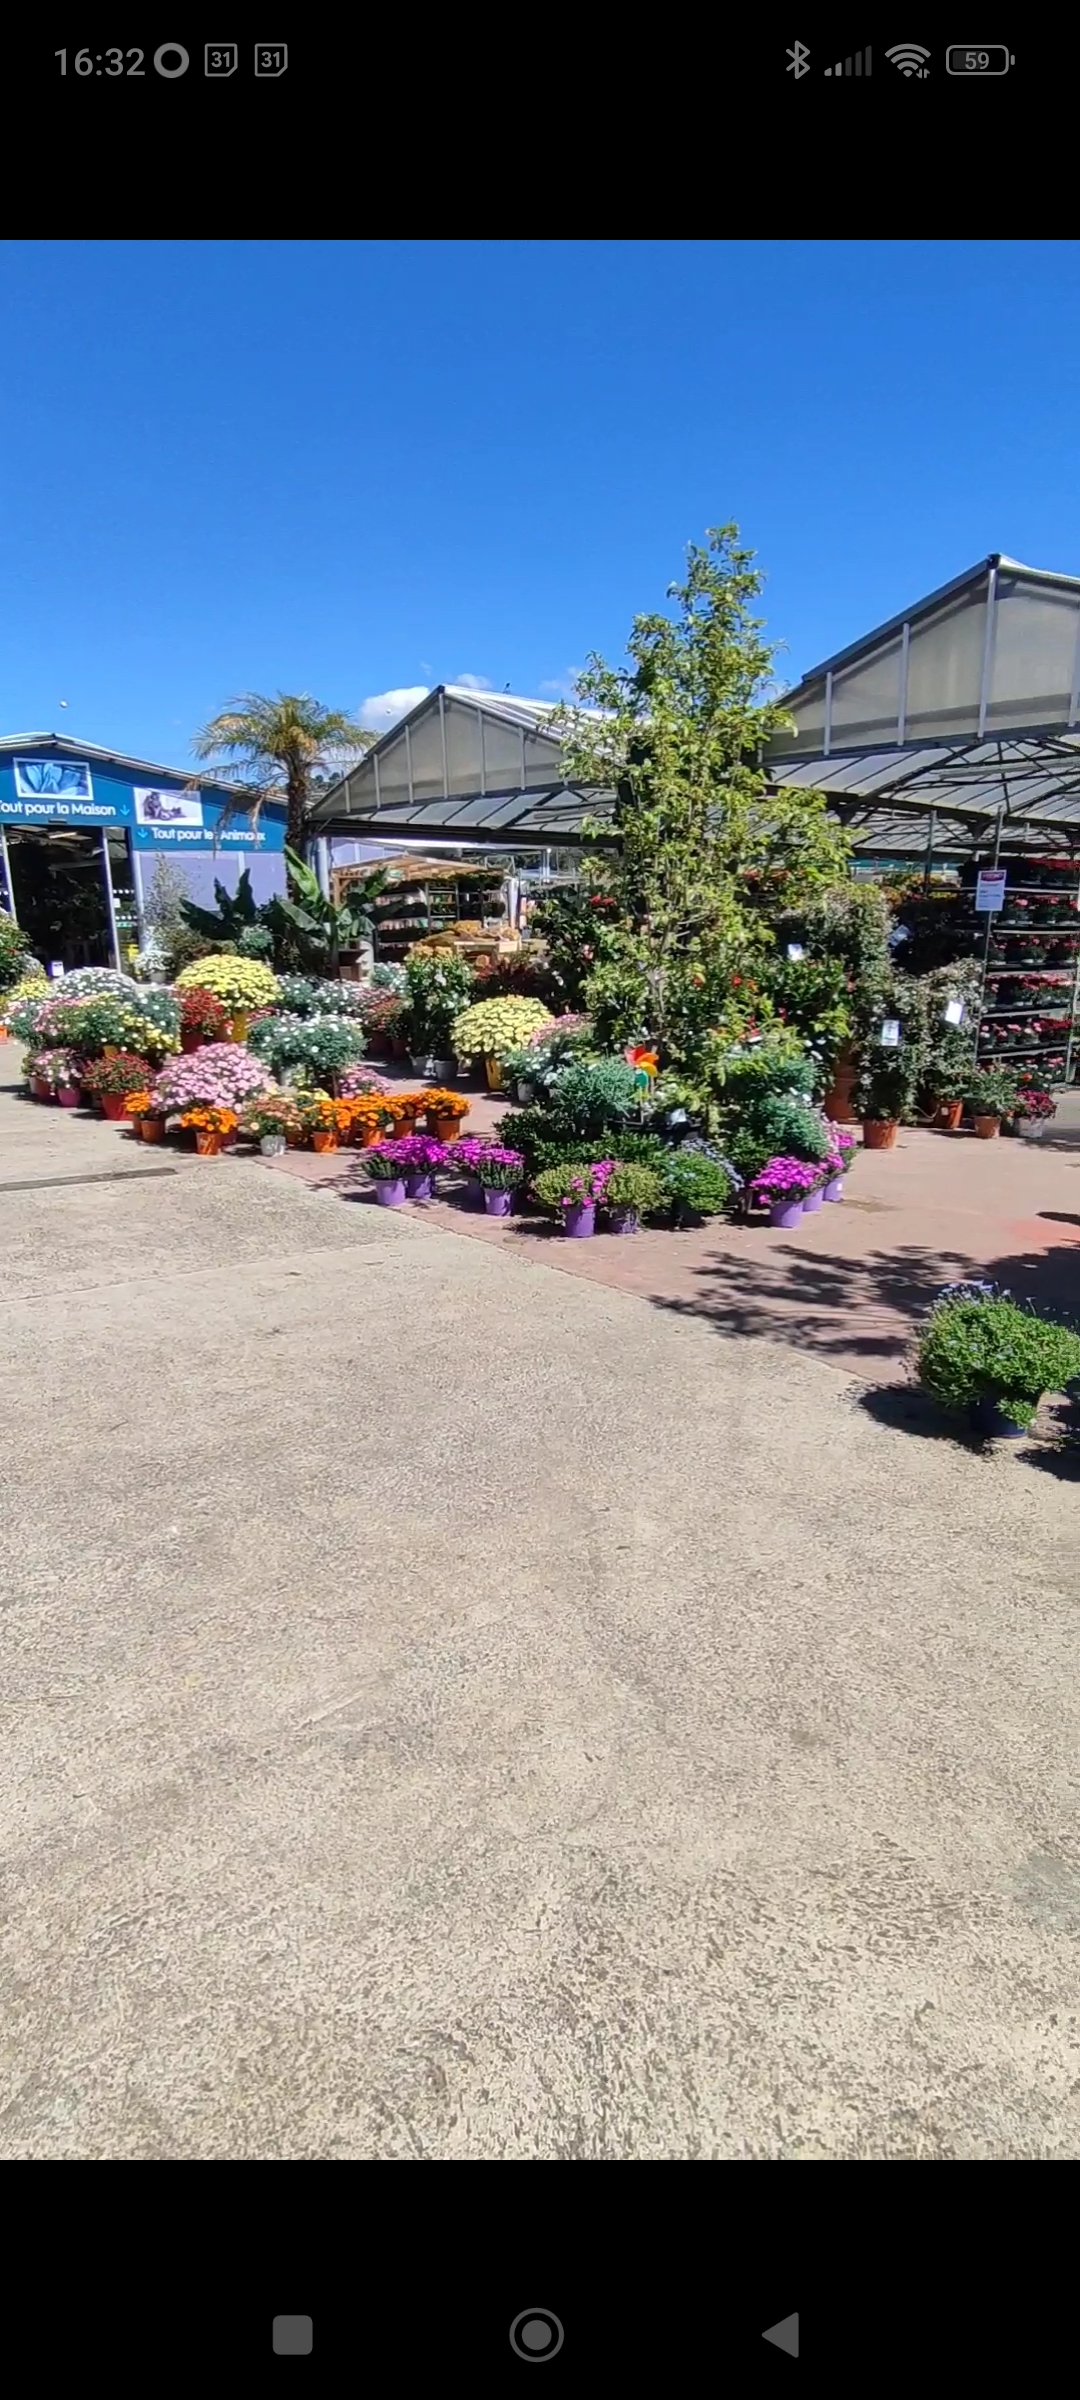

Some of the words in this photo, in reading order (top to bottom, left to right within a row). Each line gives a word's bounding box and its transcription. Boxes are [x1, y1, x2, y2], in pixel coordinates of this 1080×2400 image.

[24, 803, 55, 817] pour
[57, 802, 69, 814] la
[72, 803, 116, 816] Maison
[151, 827, 175, 840] Tout
[177, 830, 202, 842] pour
[204, 828, 218, 840] le
